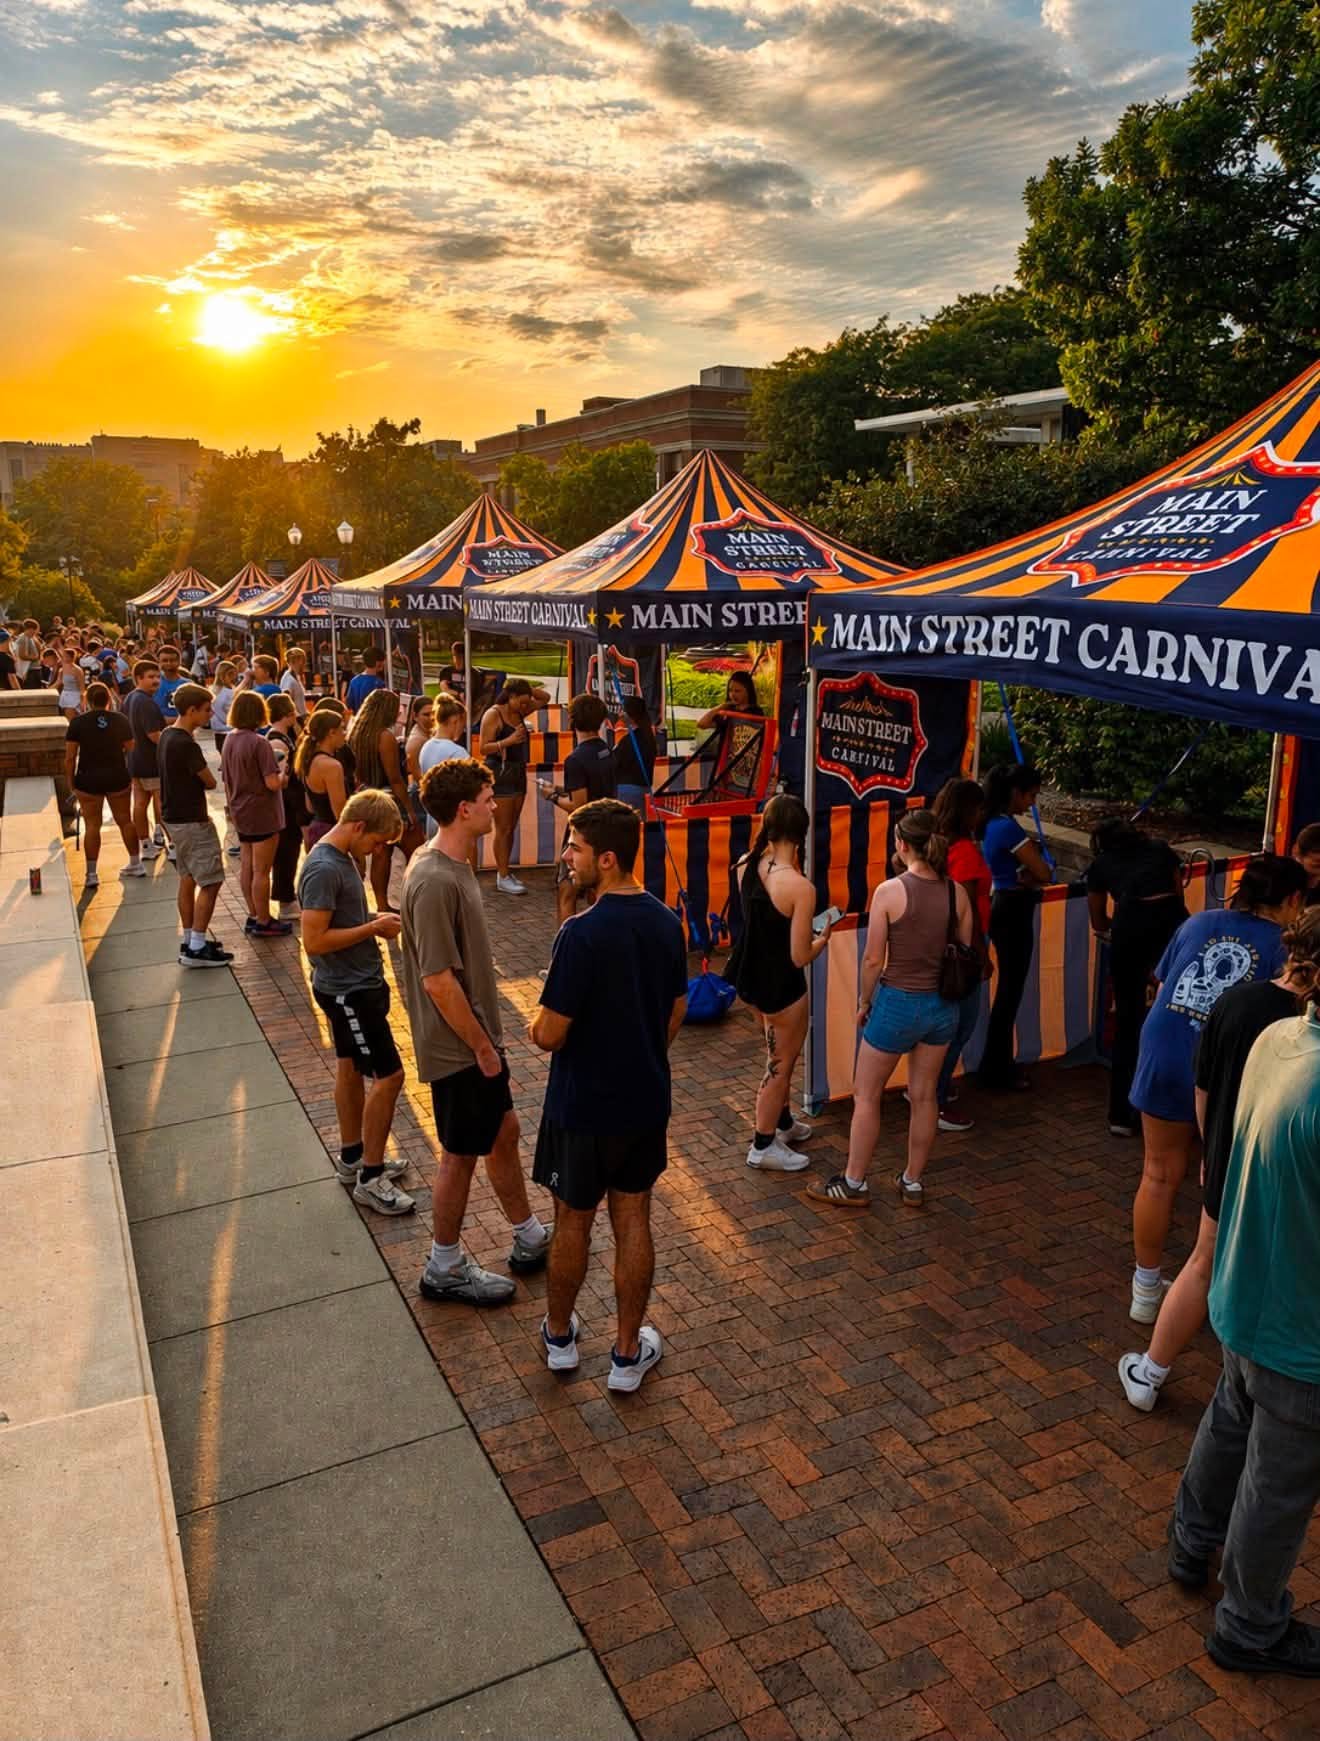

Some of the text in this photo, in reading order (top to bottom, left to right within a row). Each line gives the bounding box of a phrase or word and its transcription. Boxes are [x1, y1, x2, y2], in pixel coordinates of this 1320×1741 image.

[1147, 489, 1268, 516] MAIN
[727, 532, 790, 545] MAIN
[1100, 513, 1261, 540] STREET
[723, 544, 809, 557] STREET
[406, 593, 463, 611] MAIN
[469, 599, 588, 628] MAIN STREET CARNIVAL
[263, 619, 299, 631] MAIN
[631, 603, 713, 629] MAIN
[830, 612, 1320, 704] MAIN STREET CARNIVA
